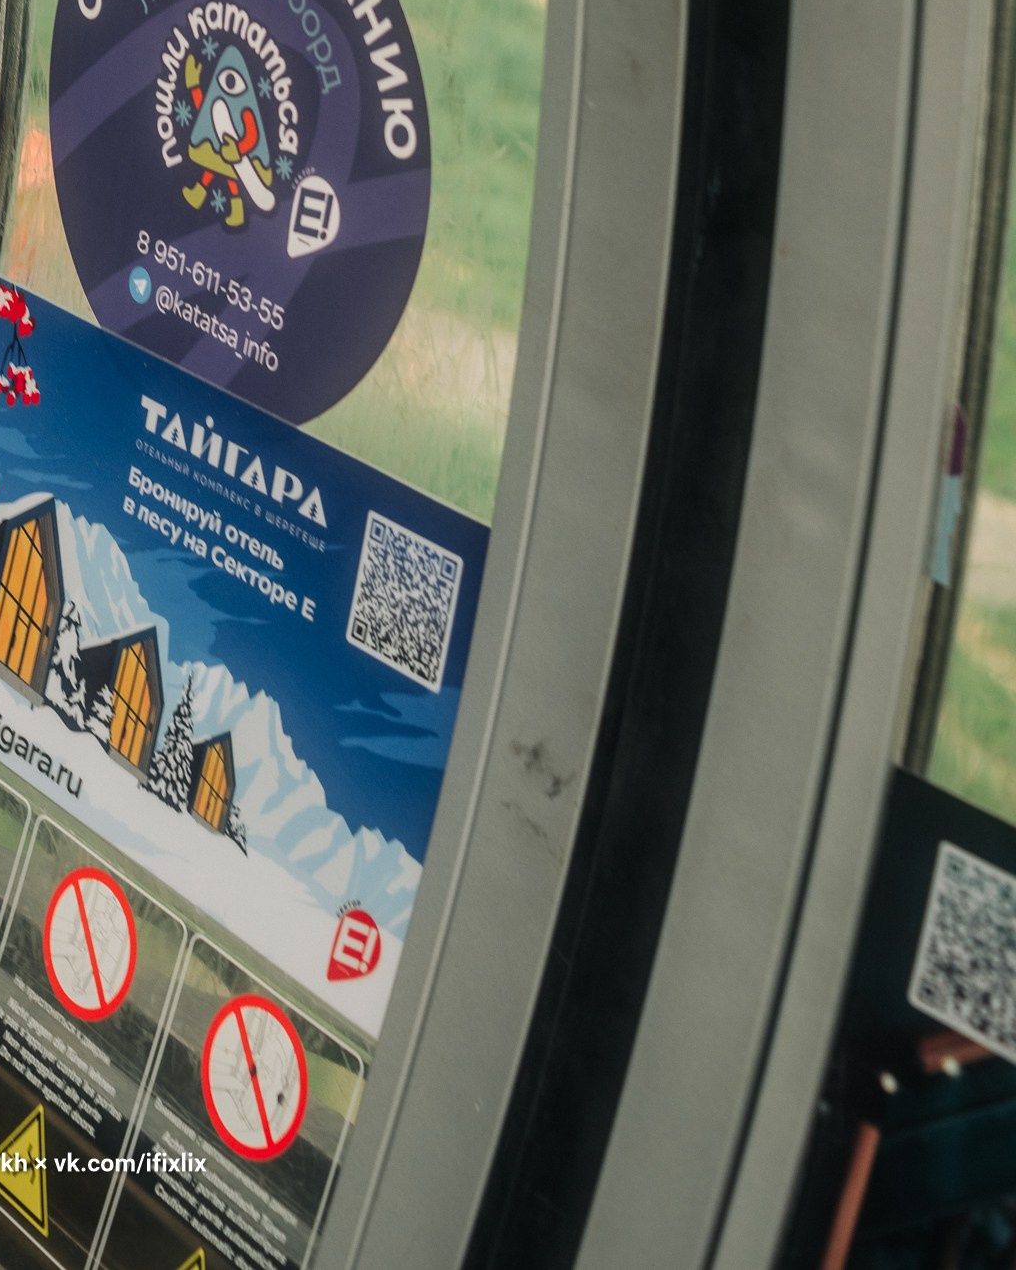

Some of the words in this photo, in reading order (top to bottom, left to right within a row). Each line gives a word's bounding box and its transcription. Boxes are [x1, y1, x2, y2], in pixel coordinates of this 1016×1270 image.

[156, 27, 190, 168] пошли
[187, 1, 299, 155] кататься
[136, 230, 150, 255] 8
[154, 240, 285, 331] 951-611-53-55
[155, 285, 279, 372] @katatsa_info
[128, 465, 222, 535] Бронируй
[225, 523, 284, 571] отель
[135, 438, 190, 477] ОТЕЛЬНЫЙ
[192, 470, 251, 510] КОМПЛЕКС
[254, 504, 262, 518] В
[265, 511, 326, 554] ШЕРЕГЕШЕ
[140, 394, 328, 528] ТАЙГАРА
[122, 495, 135, 516] в
[137, 504, 181, 547] лесу
[183, 528, 207, 558] на
[211, 545, 298, 611] Секторе
